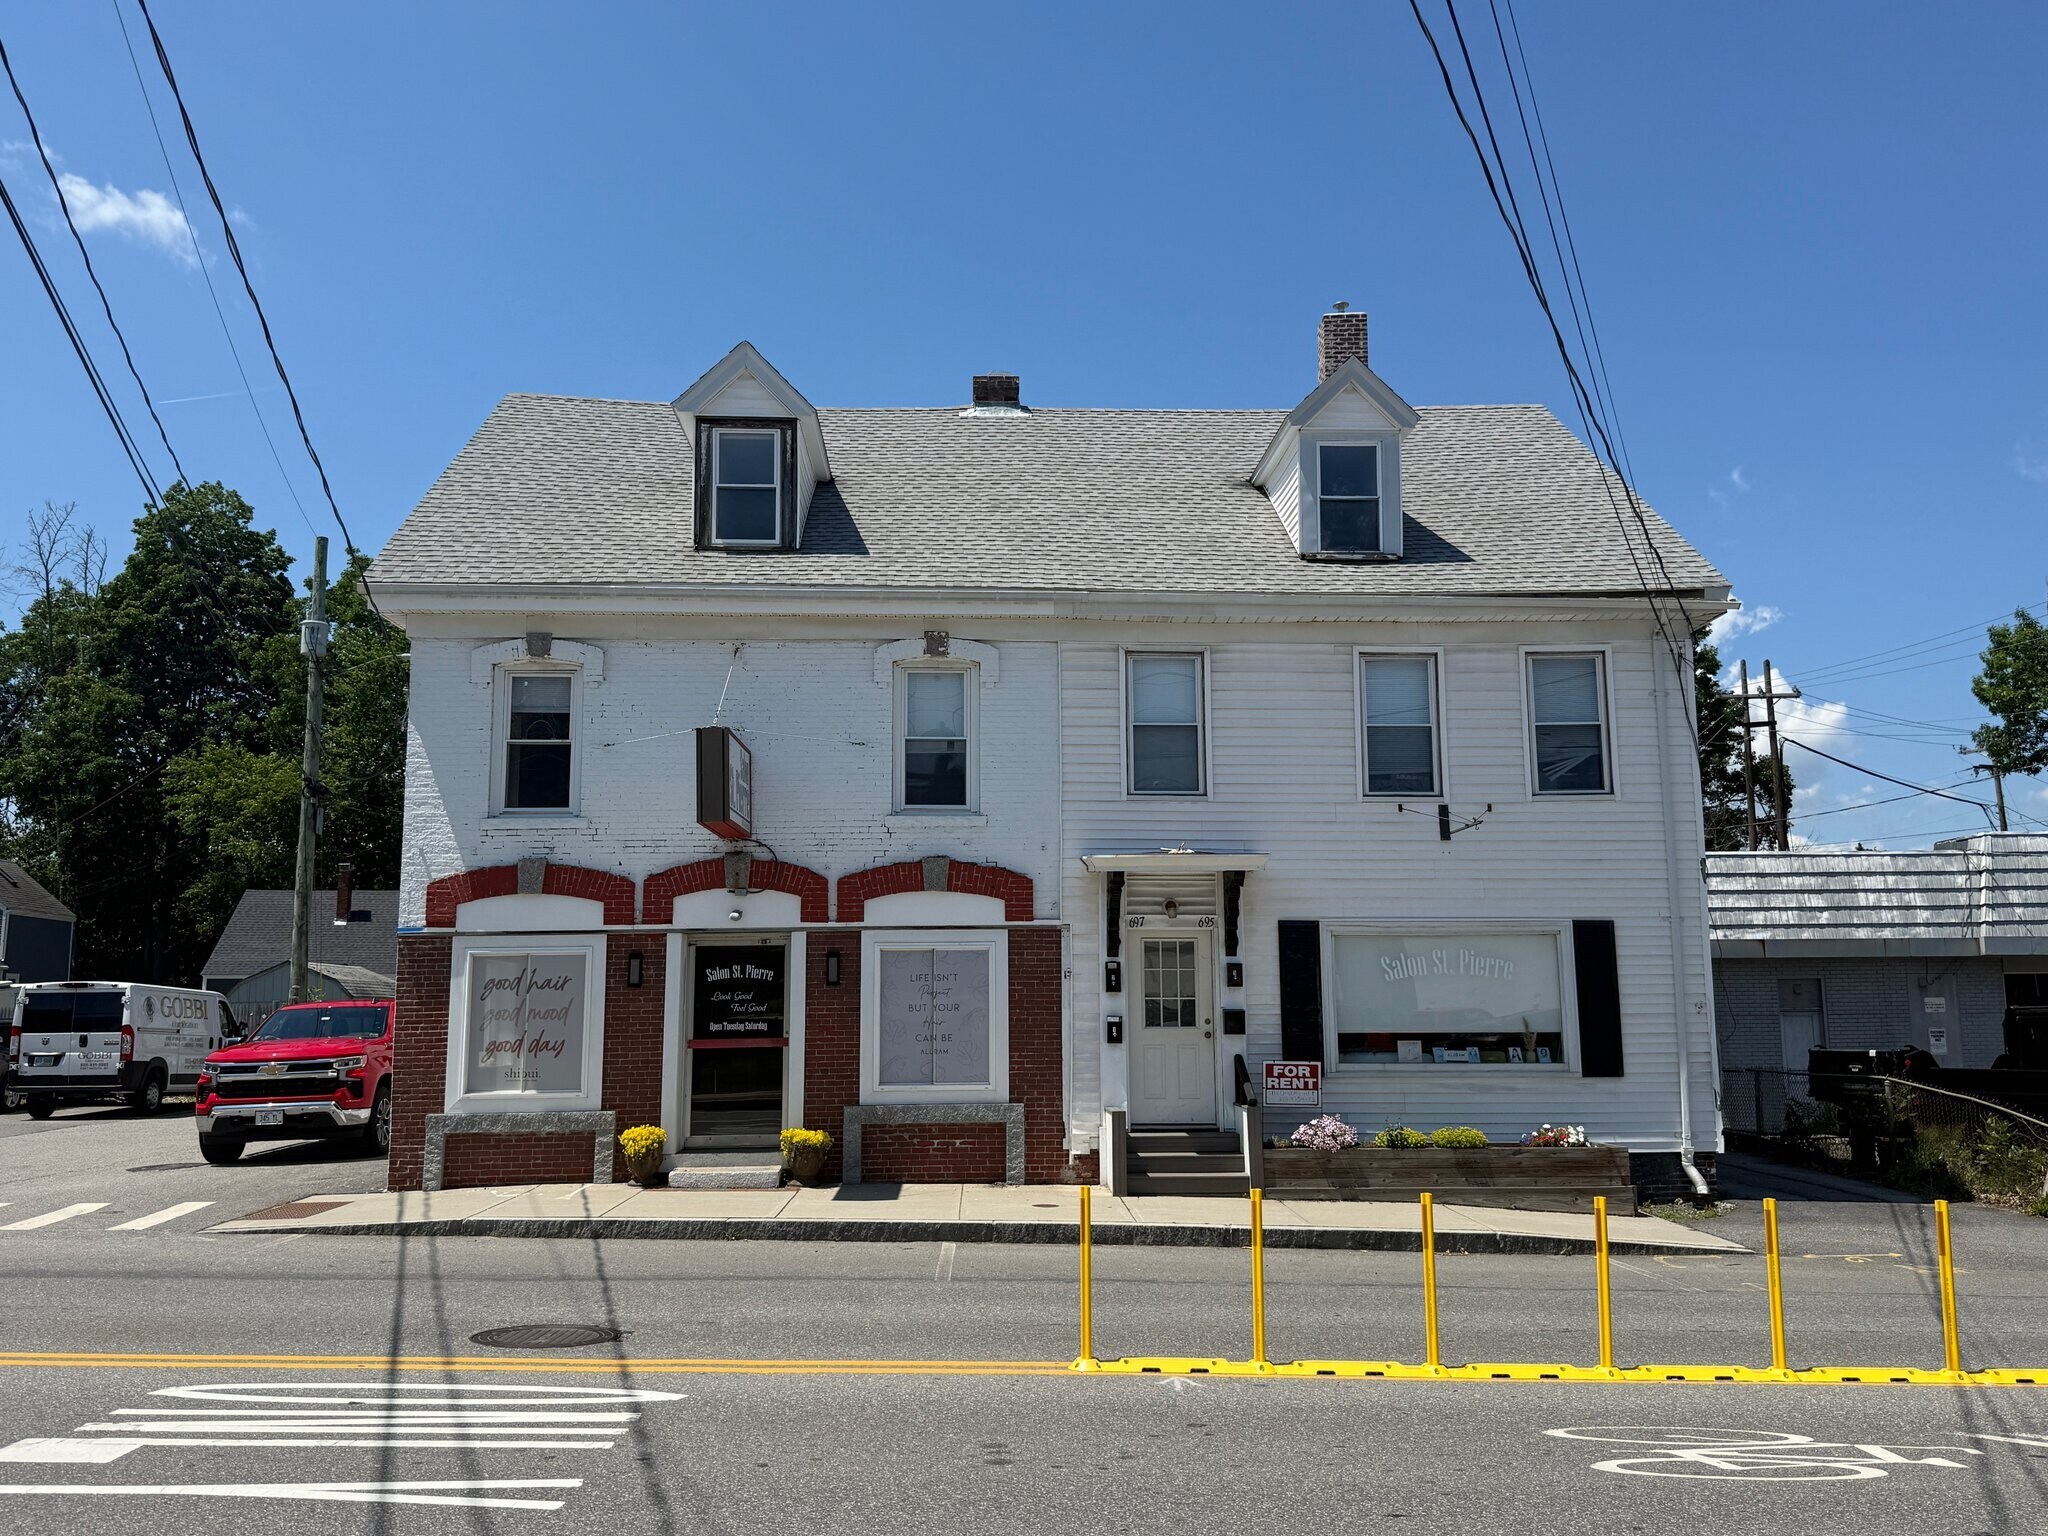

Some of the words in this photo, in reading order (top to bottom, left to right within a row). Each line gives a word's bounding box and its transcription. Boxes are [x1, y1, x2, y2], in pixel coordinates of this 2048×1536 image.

[1129, 916, 1145, 928] 697
[1198, 916, 1215, 928] 695
[1380, 952, 1427, 981] Salon
[1432, 949, 1455, 975] St.
[1459, 948, 1514, 980] Pierre
[705, 966, 731, 982] Salon
[732, 964, 744, 979] St.
[745, 964, 774, 981] Pierre
[909, 973, 930, 982] LIFE
[480, 967, 526, 1001] good
[526, 967, 573, 995] hair
[710, 991, 732, 1002] Look
[733, 991, 754, 1001] Good
[160, 995, 209, 1020] GOBBI
[748, 1002, 768, 1012] Good
[908, 1003, 927, 1012] BUT
[932, 1003, 960, 1012] YOUR
[480, 998, 526, 1032] good
[526, 997, 574, 1027] mood
[709, 1022, 723, 1032] Open
[915, 1033, 937, 1042] CAN
[941, 1033, 953, 1042] BE
[481, 1030, 527, 1063] good
[528, 1029, 566, 1059] day
[77, 1051, 112, 1060] GOBBI
[1273, 1065, 1311, 1077] FOR
[1266, 1077, 1317, 1090] RENT
